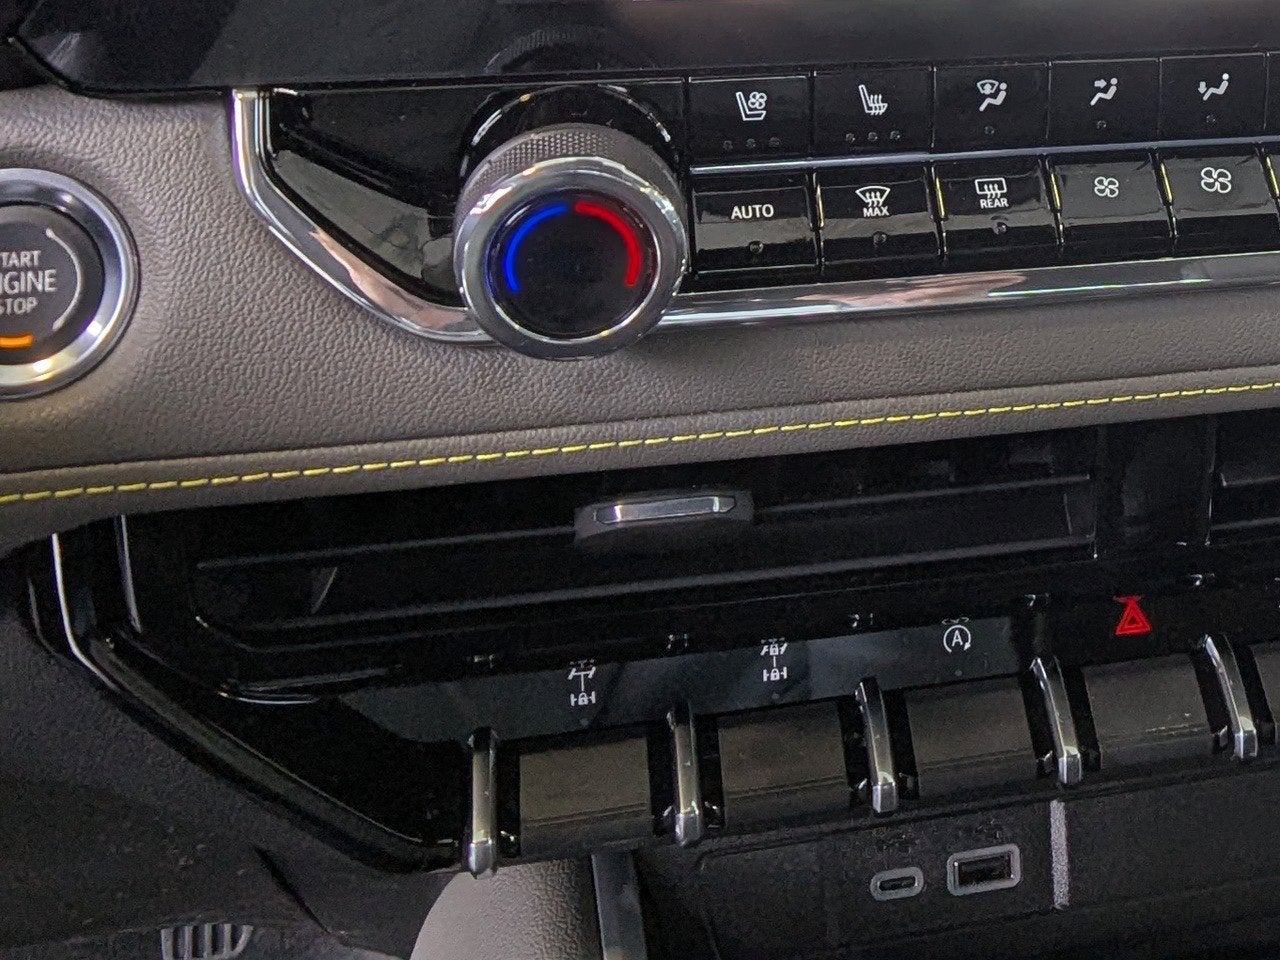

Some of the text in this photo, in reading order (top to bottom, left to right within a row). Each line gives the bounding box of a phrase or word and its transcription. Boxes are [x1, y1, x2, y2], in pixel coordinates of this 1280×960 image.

[980, 198, 1009, 210] REAR
[731, 204, 775, 220] AUTO
[863, 206, 890, 218] MAX
